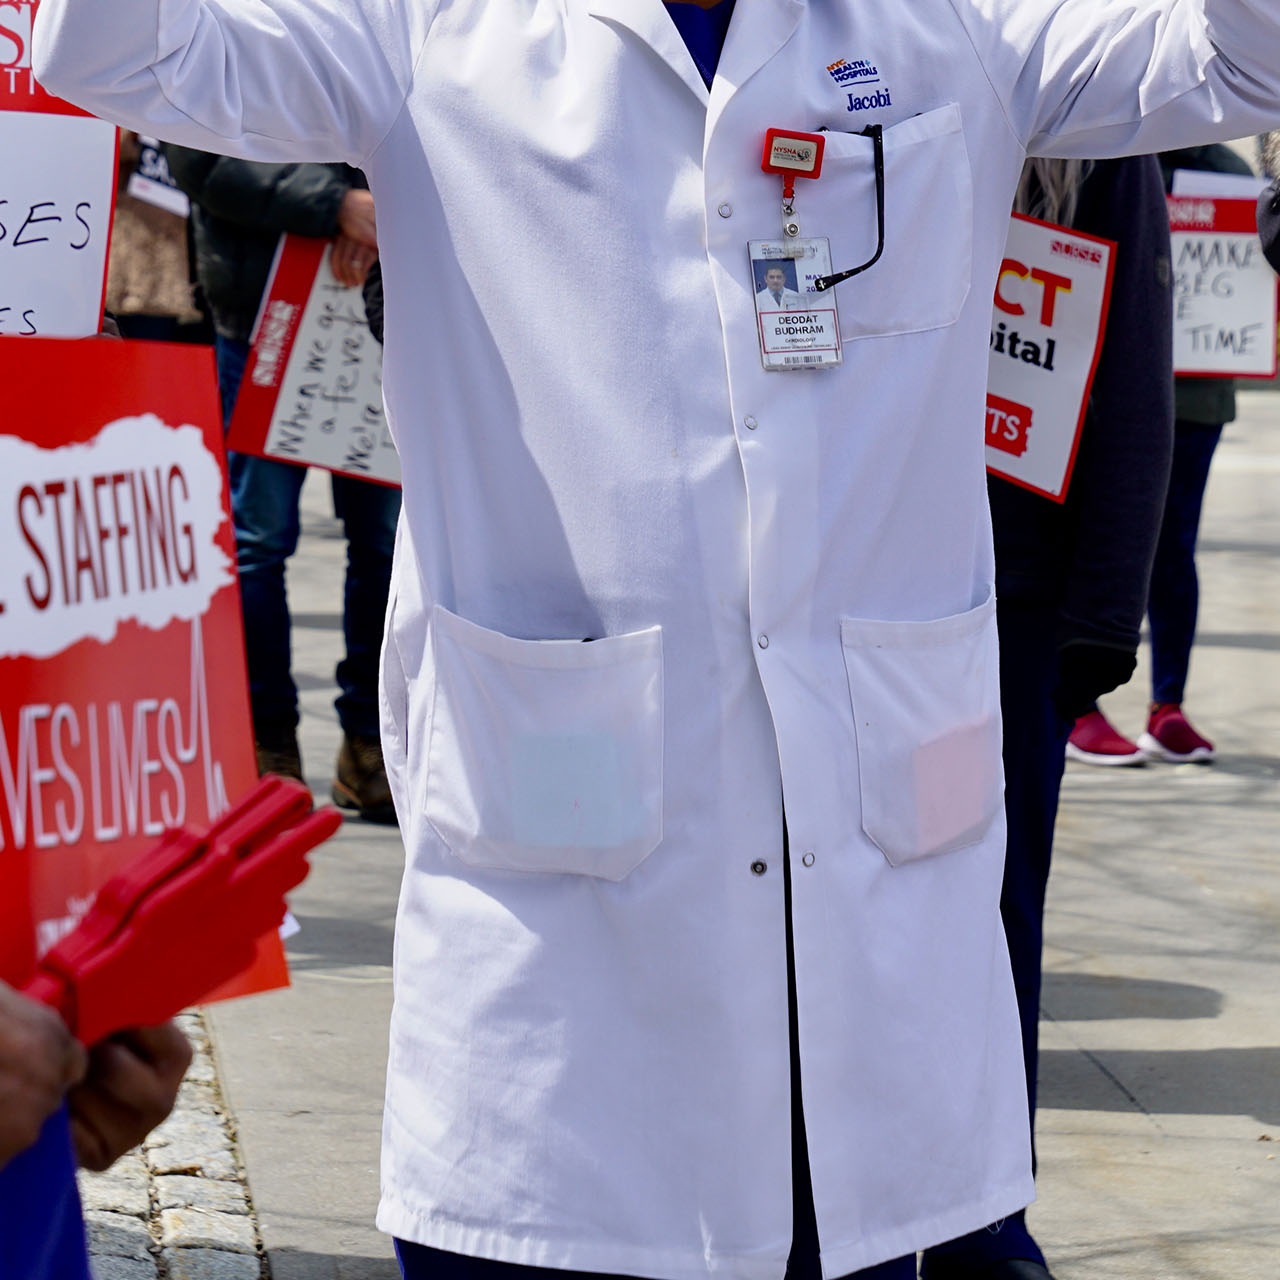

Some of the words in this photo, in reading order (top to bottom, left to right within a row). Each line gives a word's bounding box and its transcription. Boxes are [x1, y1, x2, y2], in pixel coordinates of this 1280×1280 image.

[826, 58, 847, 71] NYC
[834, 66, 878, 83] HOSPITALS
[847, 88, 892, 112] Jacobi
[774, 146, 797, 155] NYSNA
[775, 325, 824, 336] BUDHRAM
[778, 315, 818, 325] DEODAT
[989, 322, 1056, 371] ital
[1183, 322, 1263, 356] TIME
[986, 405, 1020, 441] TS
[17, 463, 199, 612] STAFFING
[87, 698, 195, 842] LIVES
